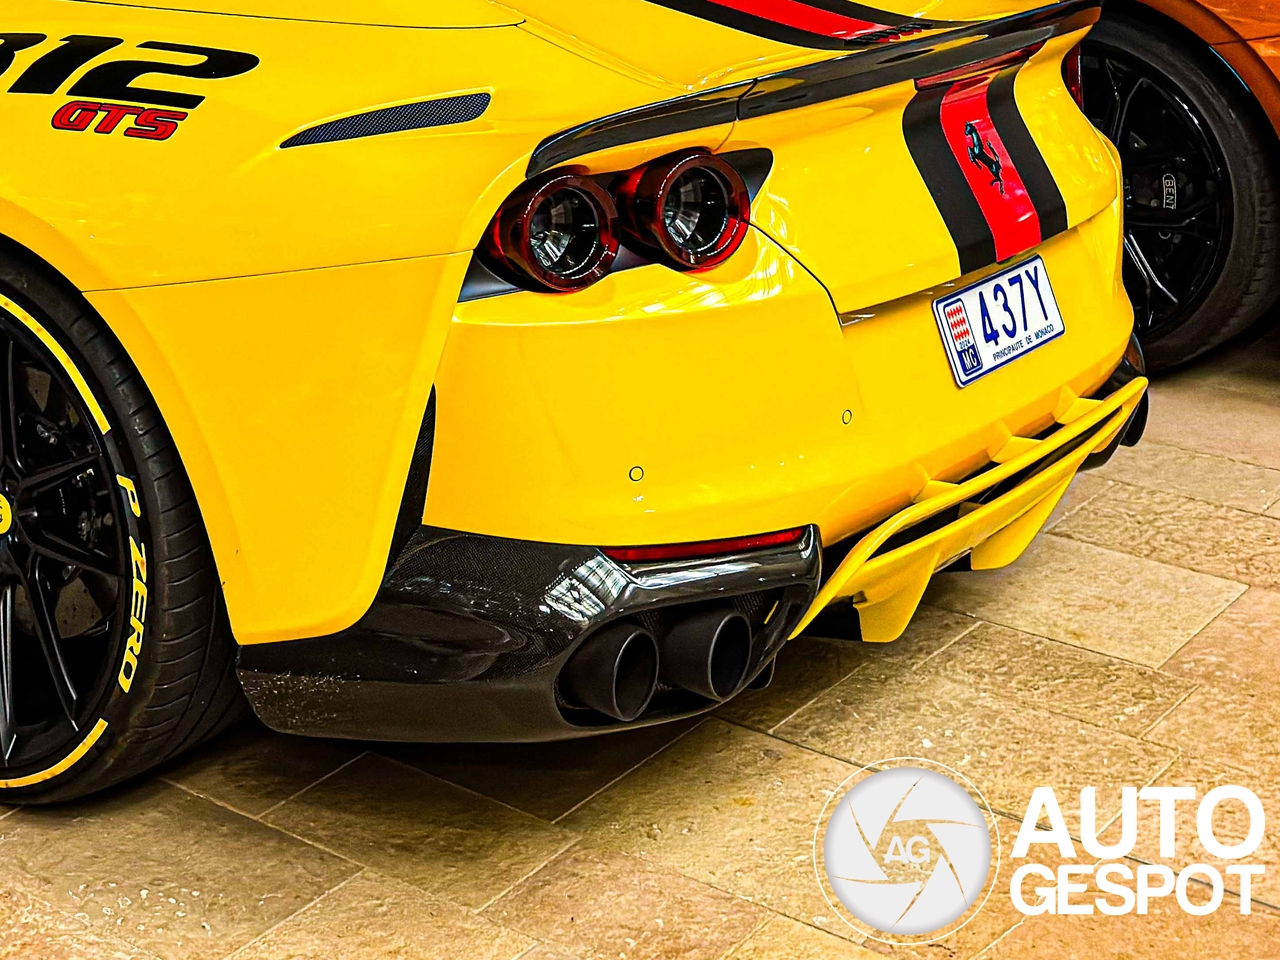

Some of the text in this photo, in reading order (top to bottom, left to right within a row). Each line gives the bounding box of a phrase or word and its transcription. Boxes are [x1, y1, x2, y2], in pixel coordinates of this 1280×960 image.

[51, 100, 189, 141] GTS
[978, 265, 1049, 346] 437Y
[1025, 334, 1033, 345] DE
[1034, 324, 1055, 340] MONACO
[962, 348, 978, 370] MC
[116, 473, 148, 693] P ZERO
